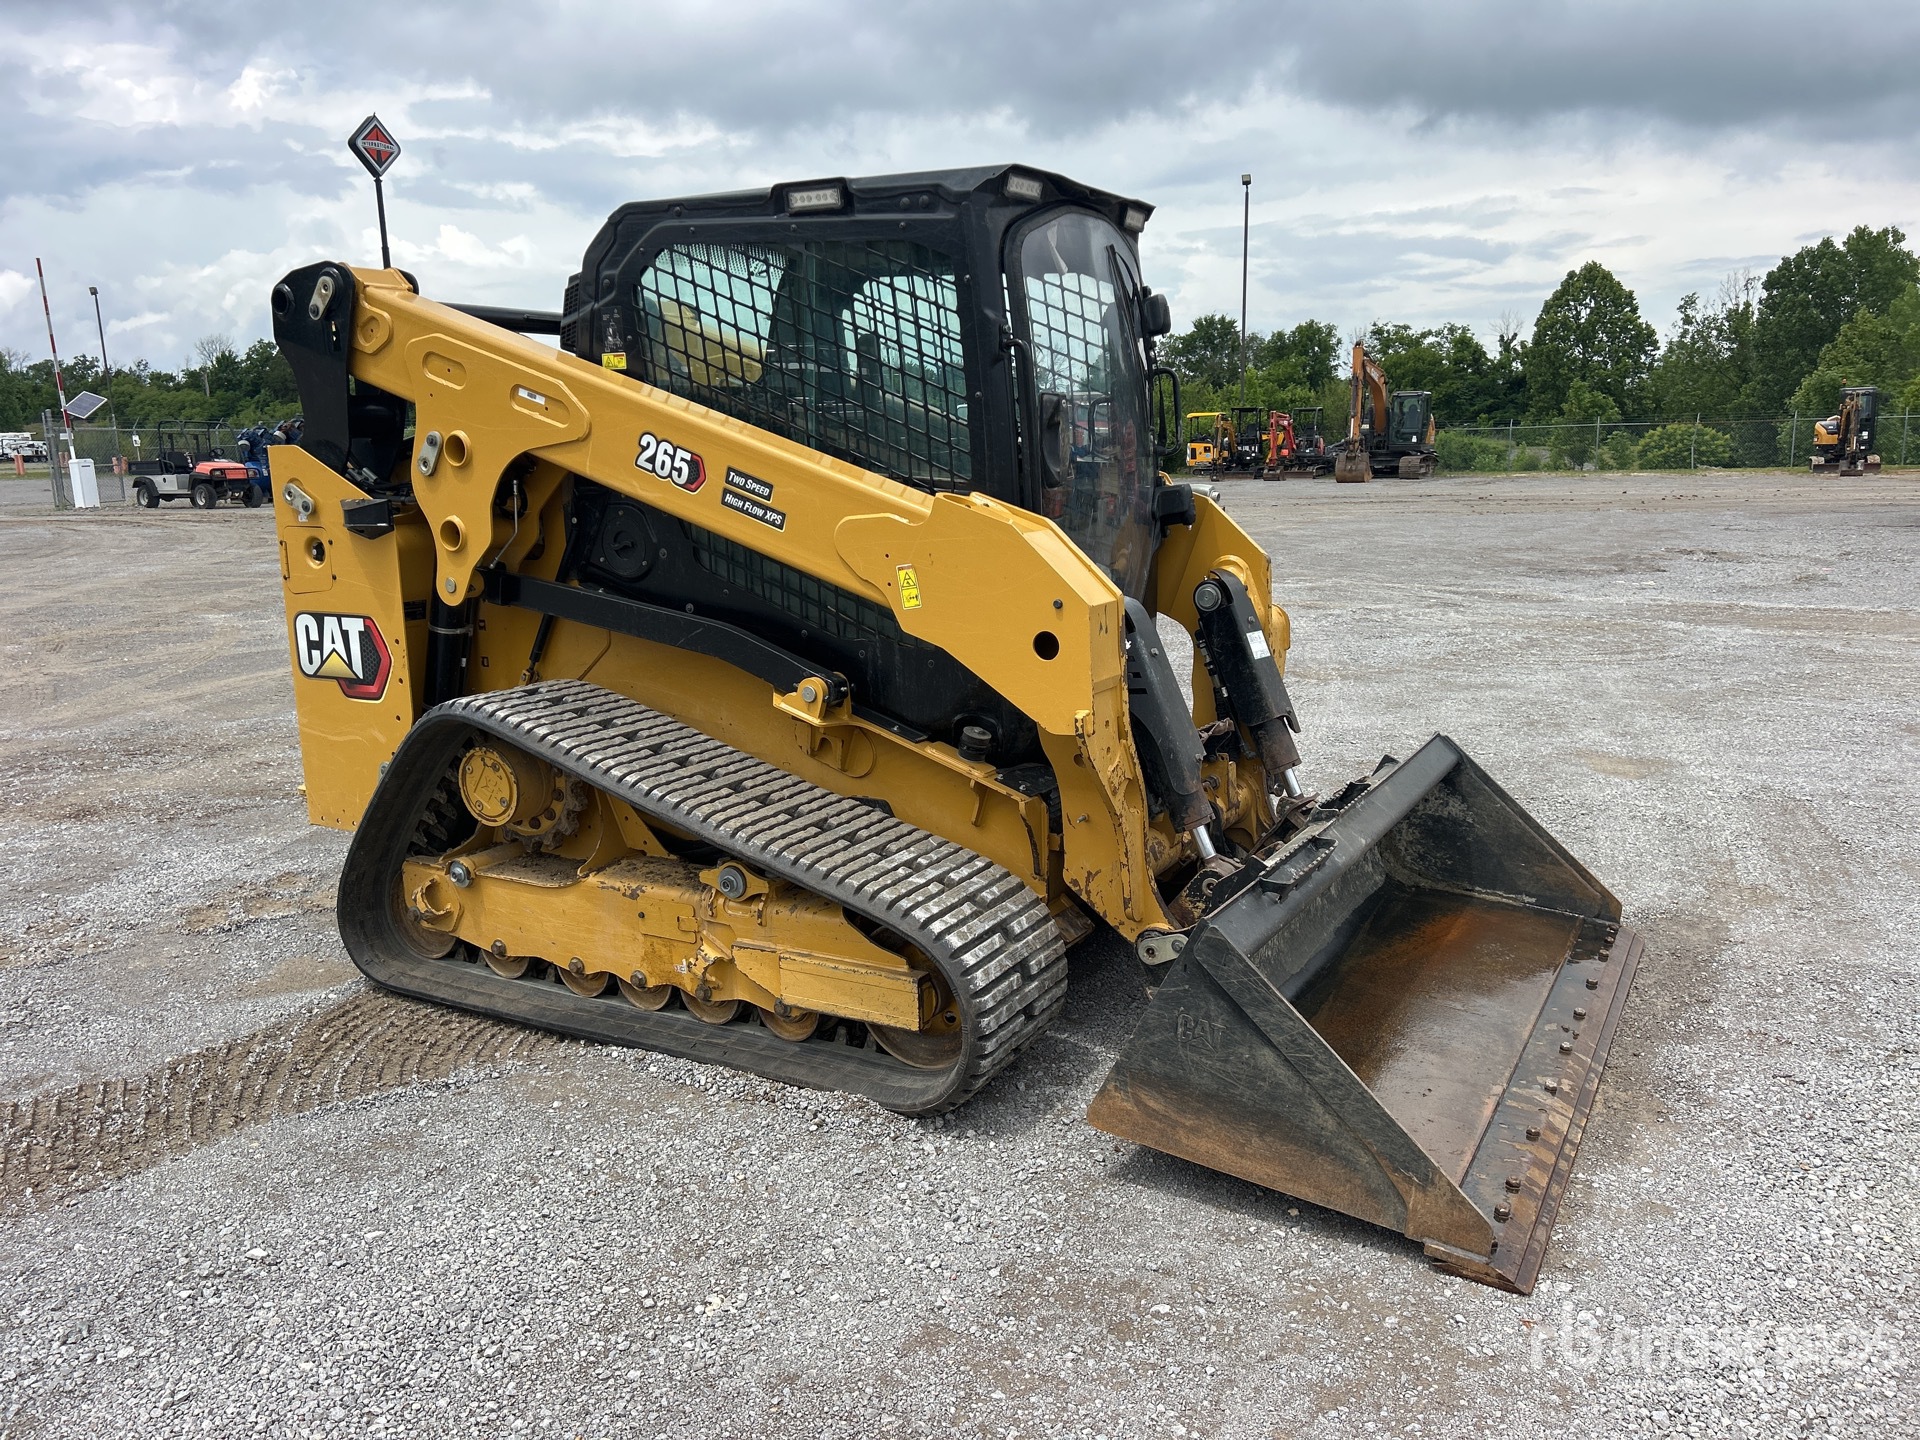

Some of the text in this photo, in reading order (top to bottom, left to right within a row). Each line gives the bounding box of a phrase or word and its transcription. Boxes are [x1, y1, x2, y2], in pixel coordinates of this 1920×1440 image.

[636, 433, 692, 485] 265
[729, 471, 770, 497] TWO SPEED
[724, 493, 783, 525] HIGH FLOW XPS
[295, 613, 365, 680] CAT
[1177, 1013, 1227, 1055] CAT
